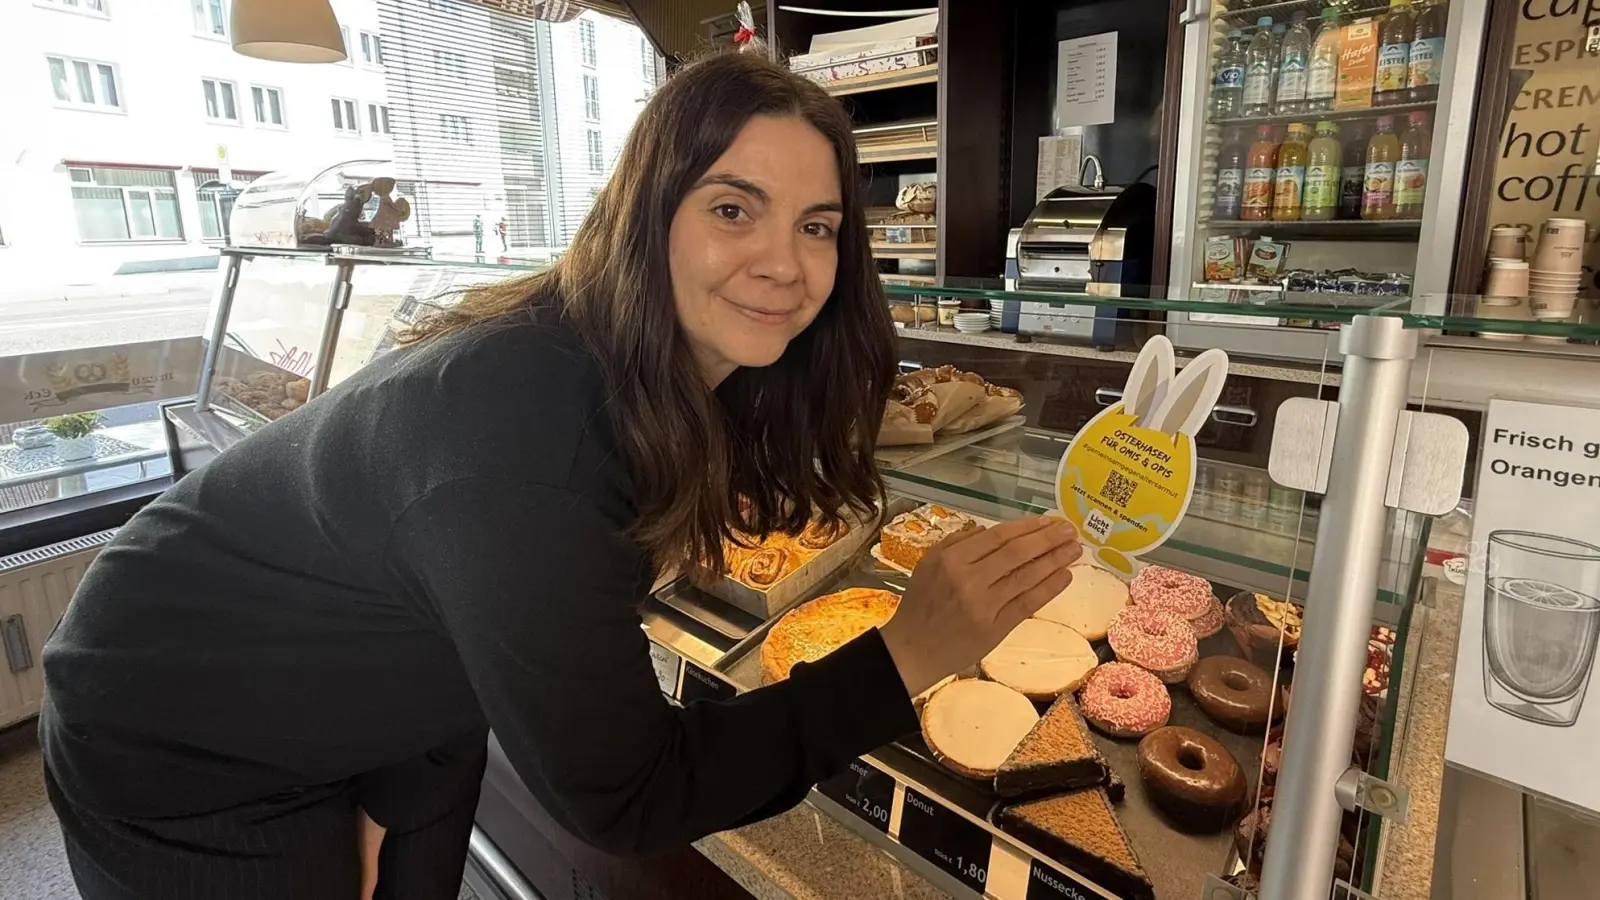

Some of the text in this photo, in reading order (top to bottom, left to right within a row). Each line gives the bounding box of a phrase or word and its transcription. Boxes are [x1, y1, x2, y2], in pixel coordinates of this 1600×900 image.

[1341, 43, 1376, 61] Hafer
[1502, 122, 1591, 158] hot
[1498, 163, 1600, 212] coff
[1114, 430, 1171, 463] OSTERHASEN
[1493, 428, 1574, 452] Frisch
[1101, 436, 1173, 478] FÜR OMIS & OPIS
[1490, 459, 1600, 488] Orangen
[1070, 484, 1086, 496] Jetzt
[1087, 494, 1112, 512] scannen
[1119, 514, 1148, 533] spenden
[1087, 521, 1106, 536] blick
[1091, 514, 1110, 530] Licht
[850, 762, 868, 777] aner
[862, 798, 888, 822] 2,00
[907, 792, 934, 816] Donut
[956, 856, 986, 884] 1,80
